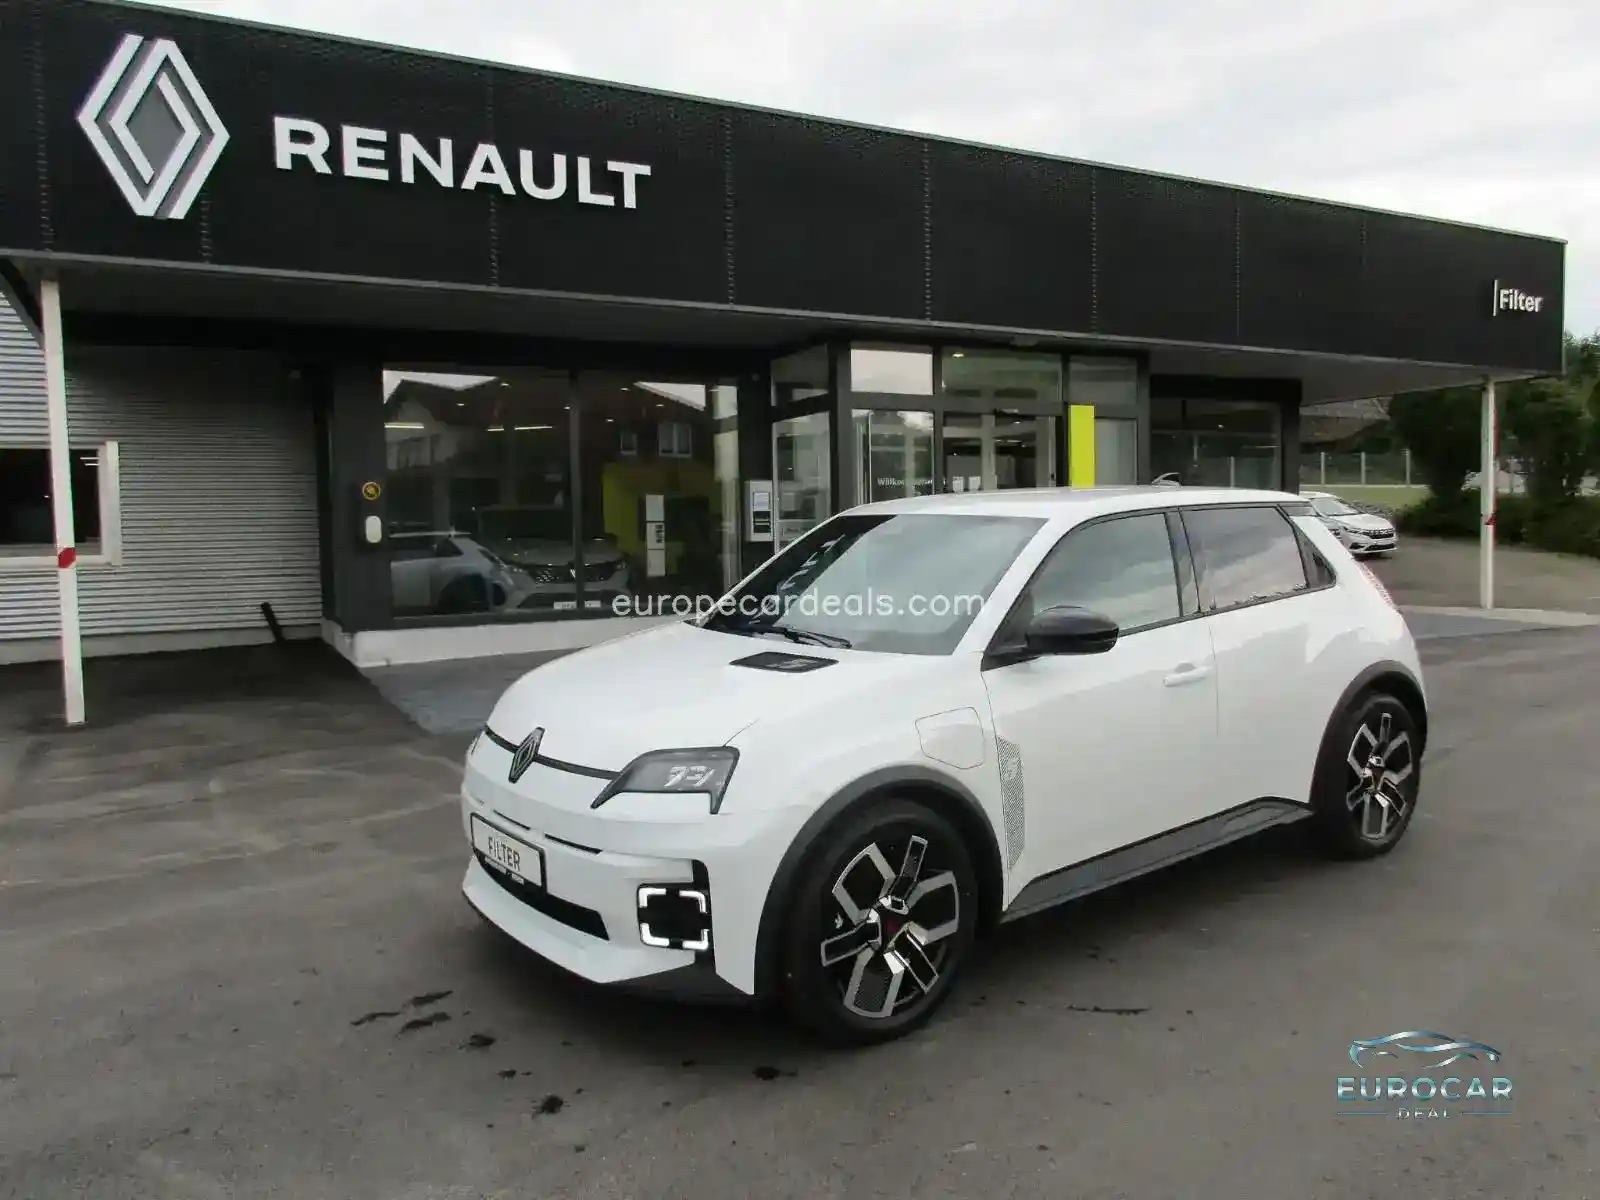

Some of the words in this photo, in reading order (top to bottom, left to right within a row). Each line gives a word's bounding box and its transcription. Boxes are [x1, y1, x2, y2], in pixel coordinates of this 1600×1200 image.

[273, 115, 652, 209] RENAULT
[1500, 288, 1543, 312] Filter
[488, 836, 521, 871] FILTER
